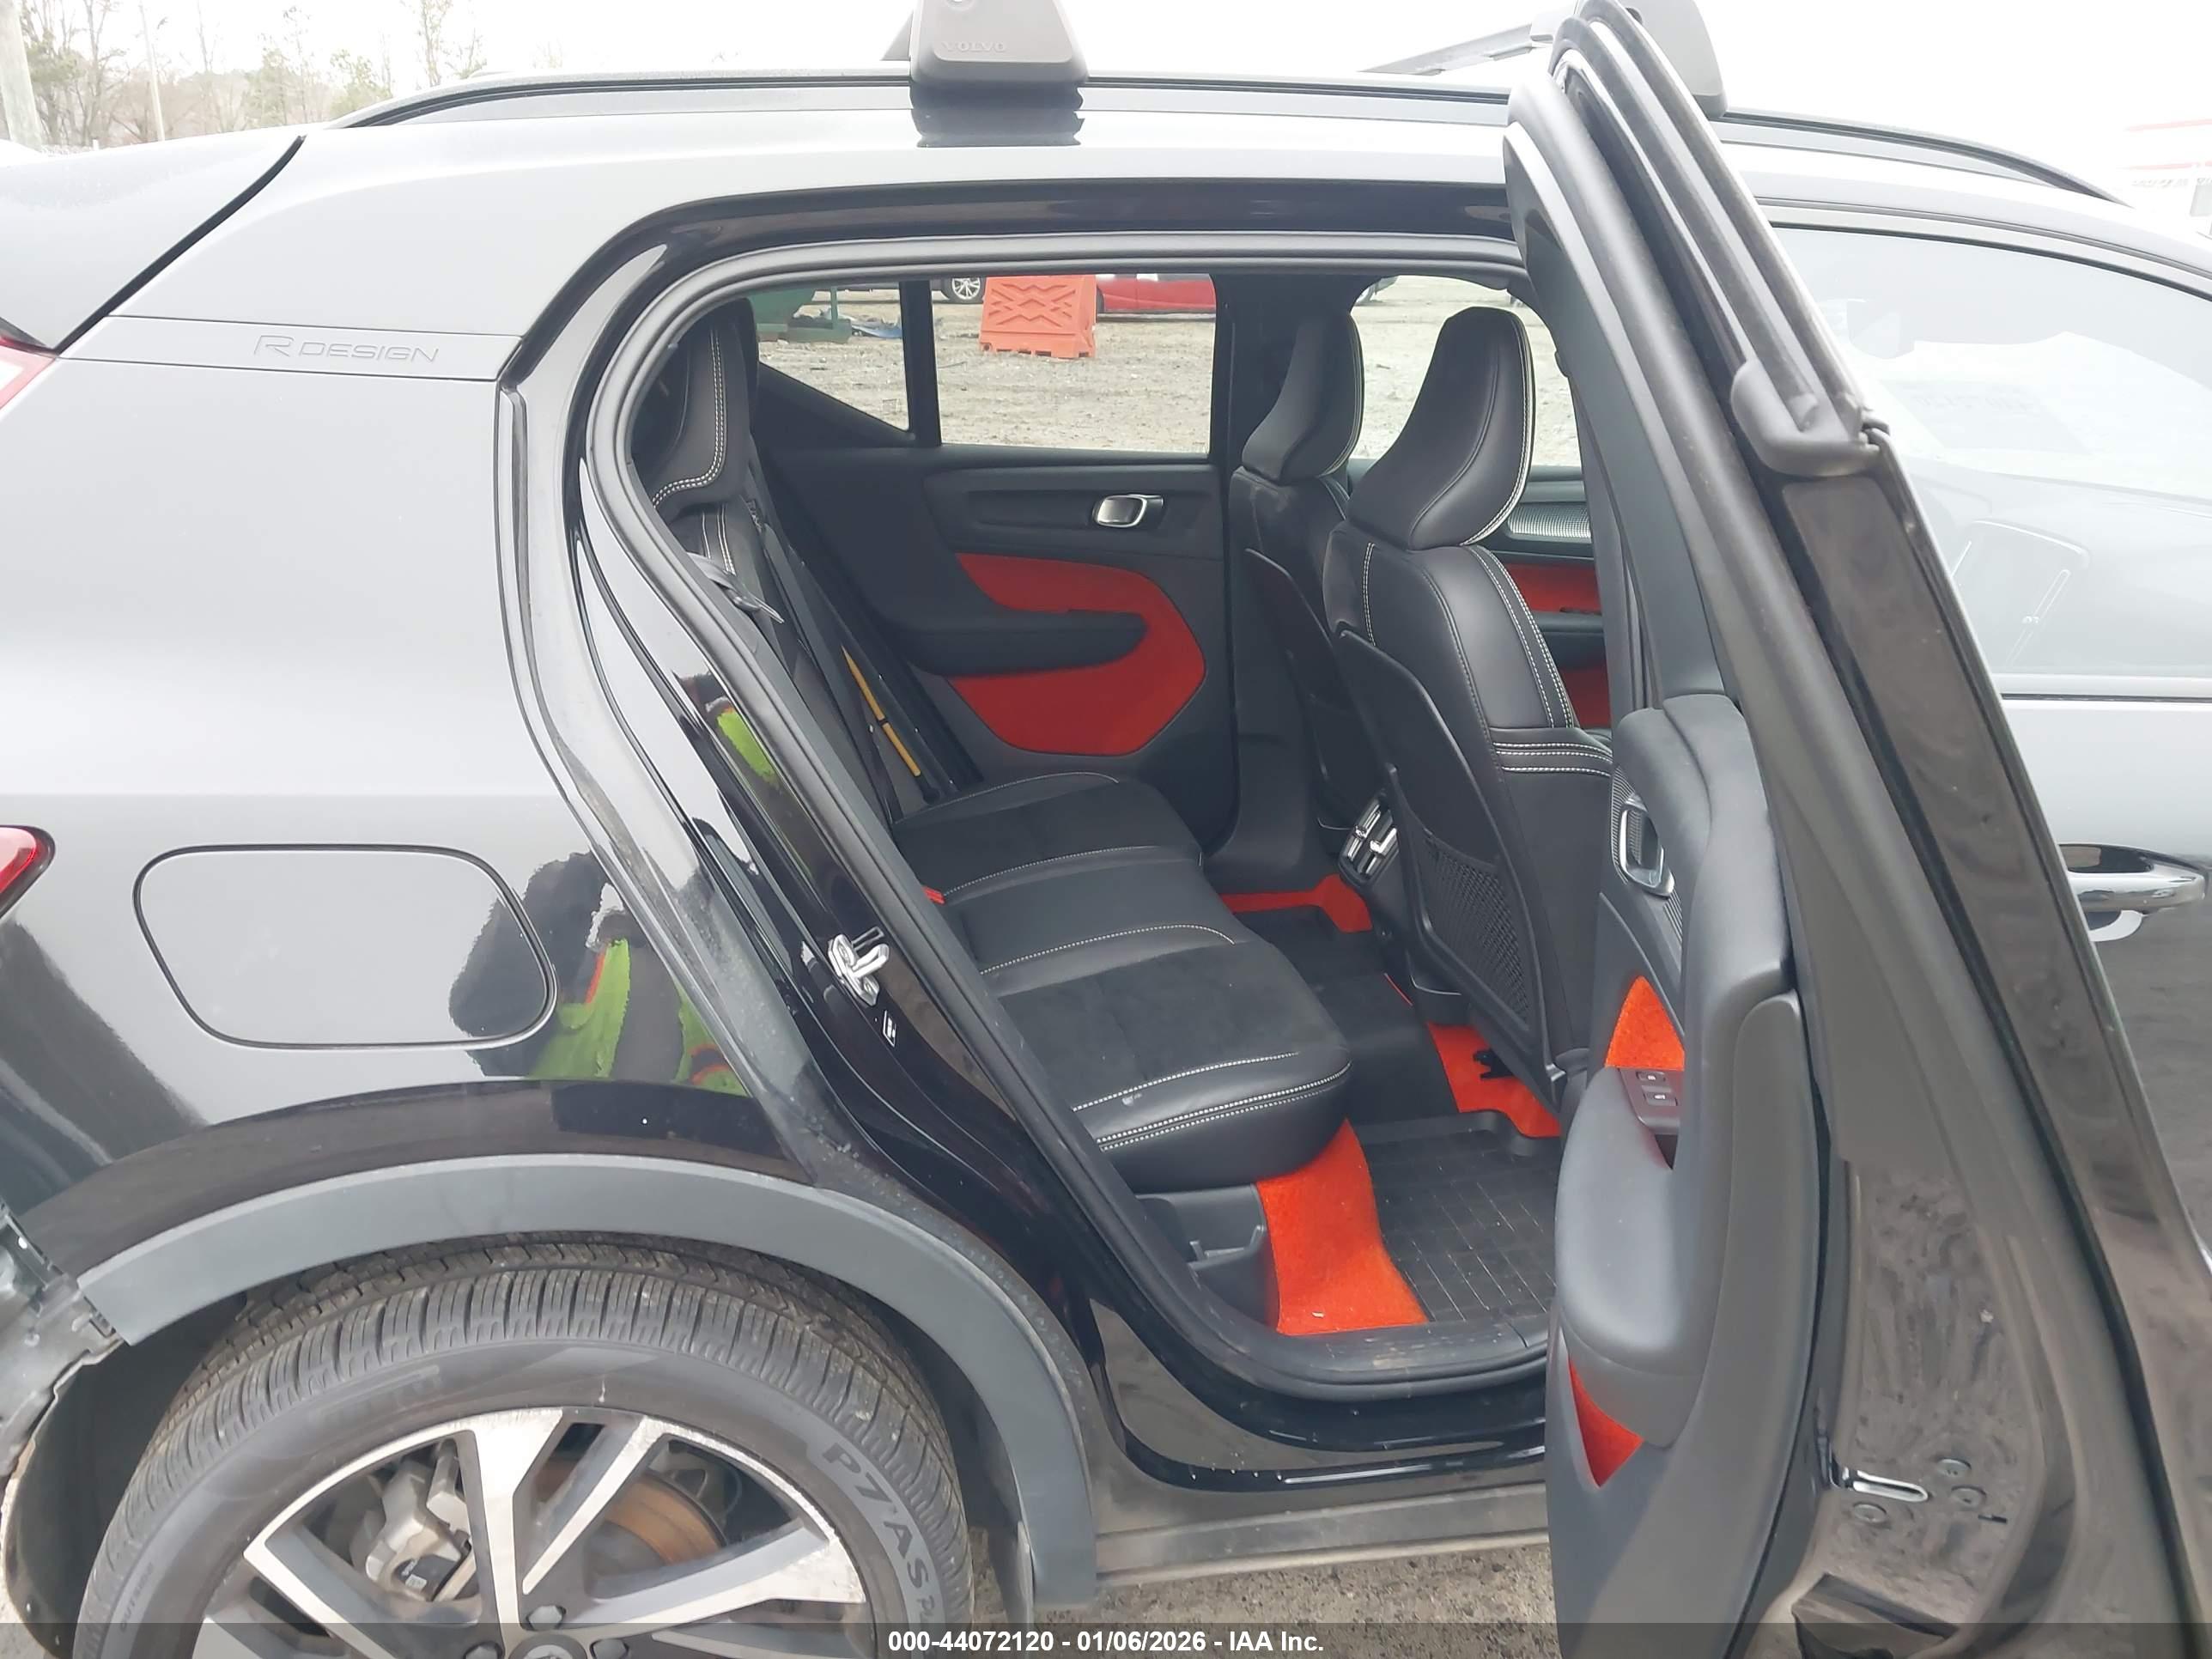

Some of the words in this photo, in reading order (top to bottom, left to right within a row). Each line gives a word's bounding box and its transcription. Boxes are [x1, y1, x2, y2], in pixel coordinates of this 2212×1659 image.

[943, 41, 1006, 52] VOLVO
[253, 335, 295, 357] R
[300, 342, 439, 362] DESIGN
